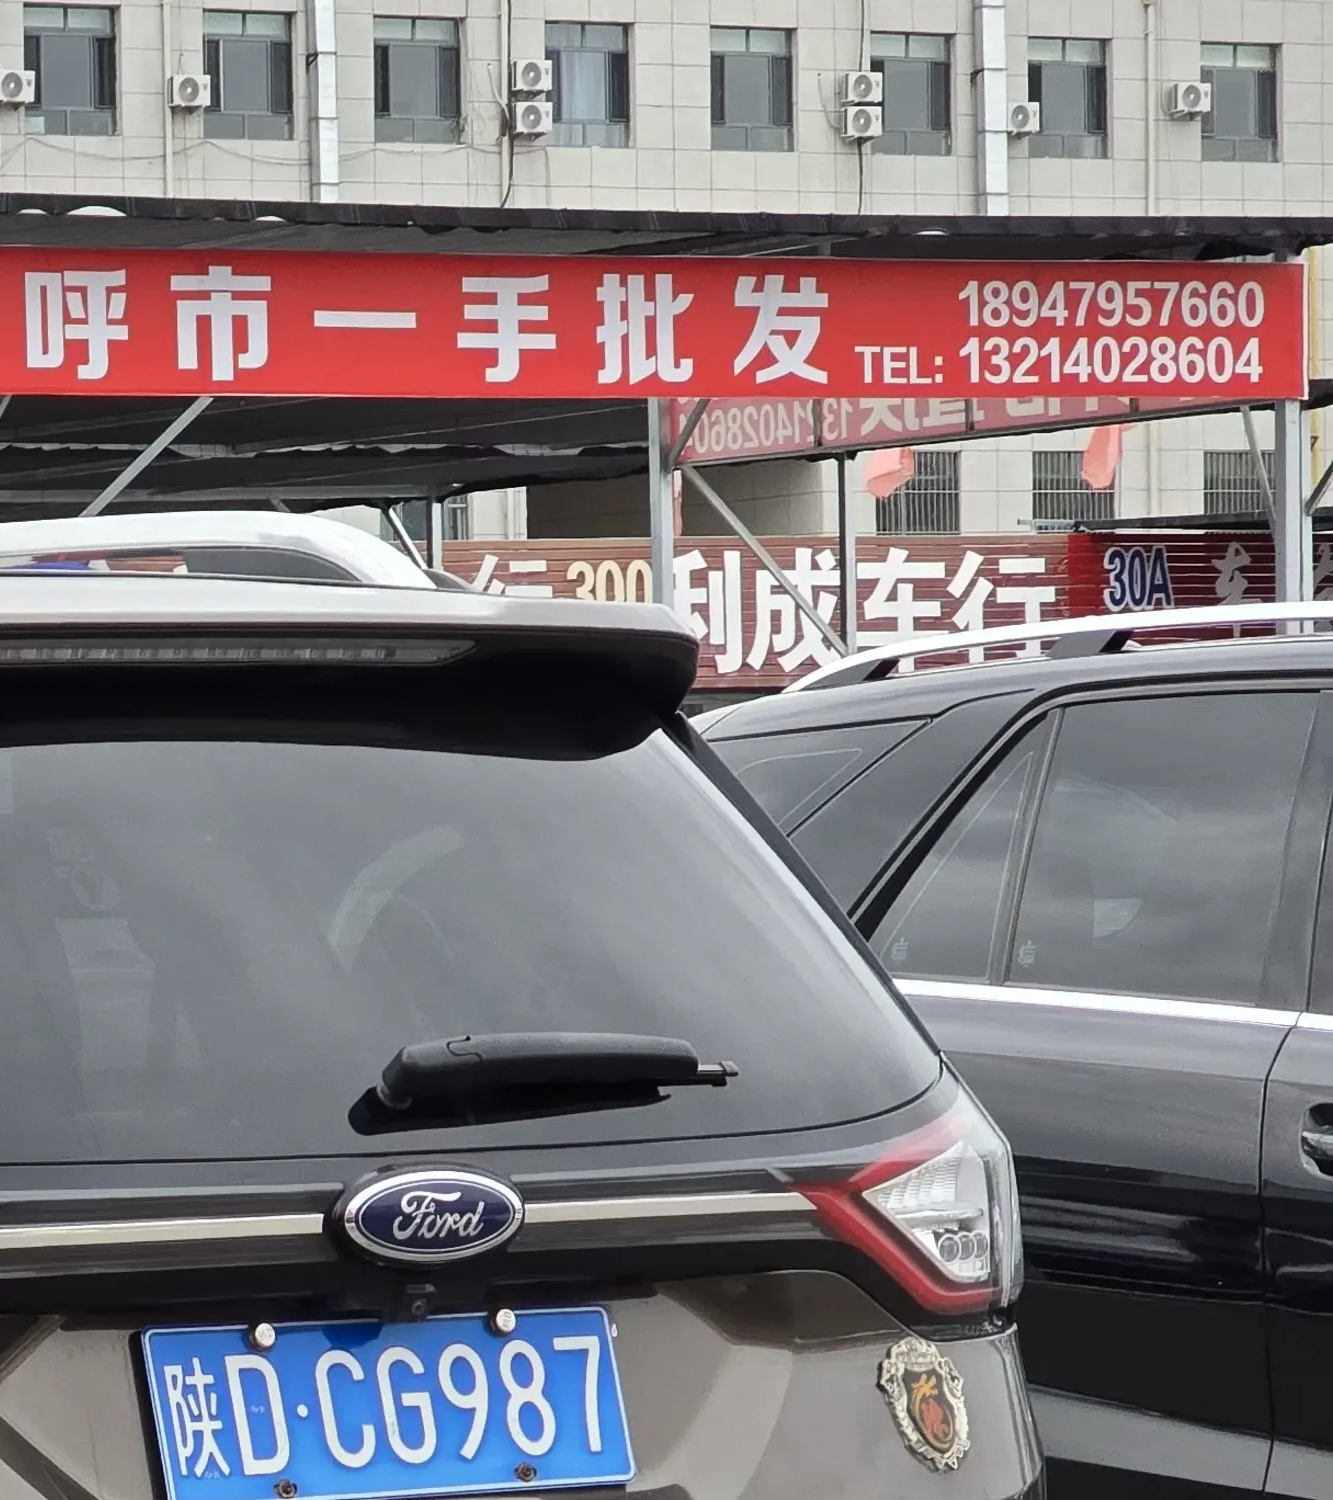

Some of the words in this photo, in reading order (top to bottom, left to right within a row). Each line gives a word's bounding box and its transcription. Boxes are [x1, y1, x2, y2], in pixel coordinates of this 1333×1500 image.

[958, 280, 1265, 328] 18947957660
[854, 345, 944, 384] TEL:
[958, 336, 1264, 384] 13214028604
[1104, 545, 1174, 612] 30A
[673, 546, 1056, 674] 利成车行
[393, 1191, 486, 1240] Ford
